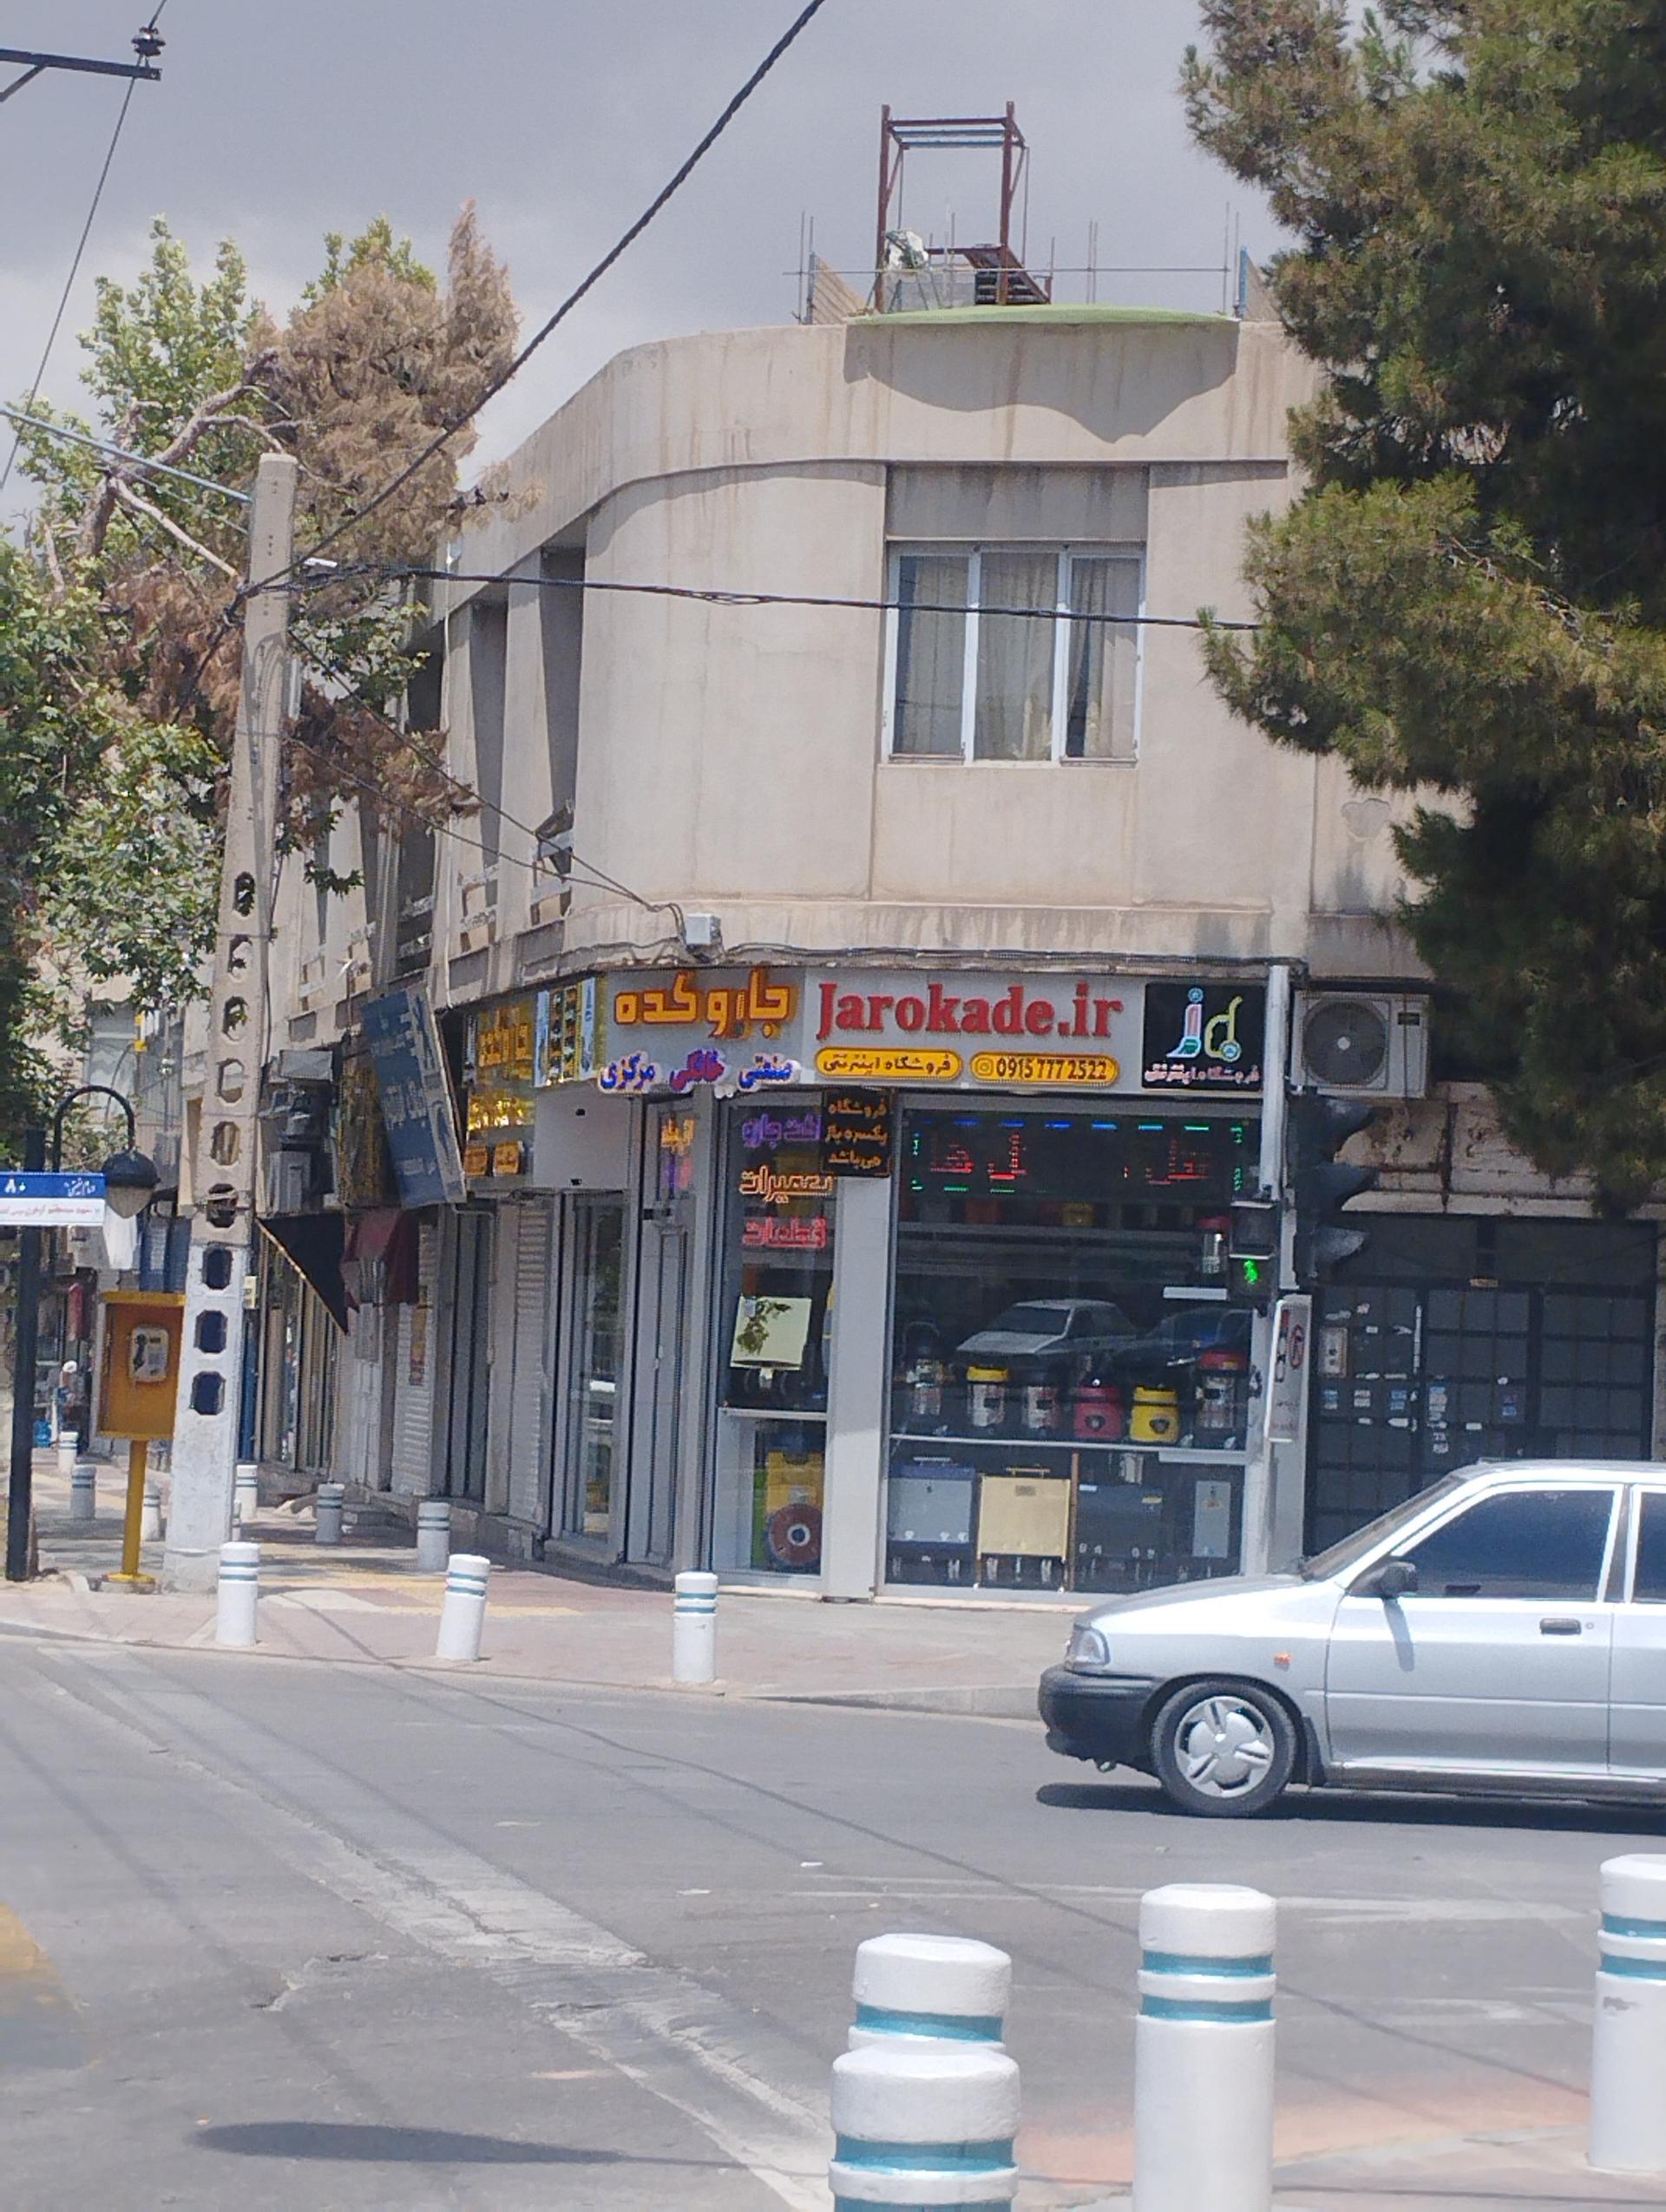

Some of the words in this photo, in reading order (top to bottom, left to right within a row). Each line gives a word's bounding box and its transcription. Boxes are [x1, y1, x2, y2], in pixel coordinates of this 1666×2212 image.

[817, 982, 1122, 1039] Jarokade.ir
[600, 1052, 657, 1090] مرکزی
[823, 1053, 880, 1076] اینترنتی
[885, 1052, 952, 1074] فروشگاه
[1145, 1063, 1197, 1084] اینترنتی
[1197, 1064, 1261, 1084] فروشگاه
[829, 1097, 888, 1119] فروشگاه
[825, 1123, 843, 1145] باز
[845, 1124, 889, 1147] یکسره
[739, 1165, 836, 1204] تعمیرات
